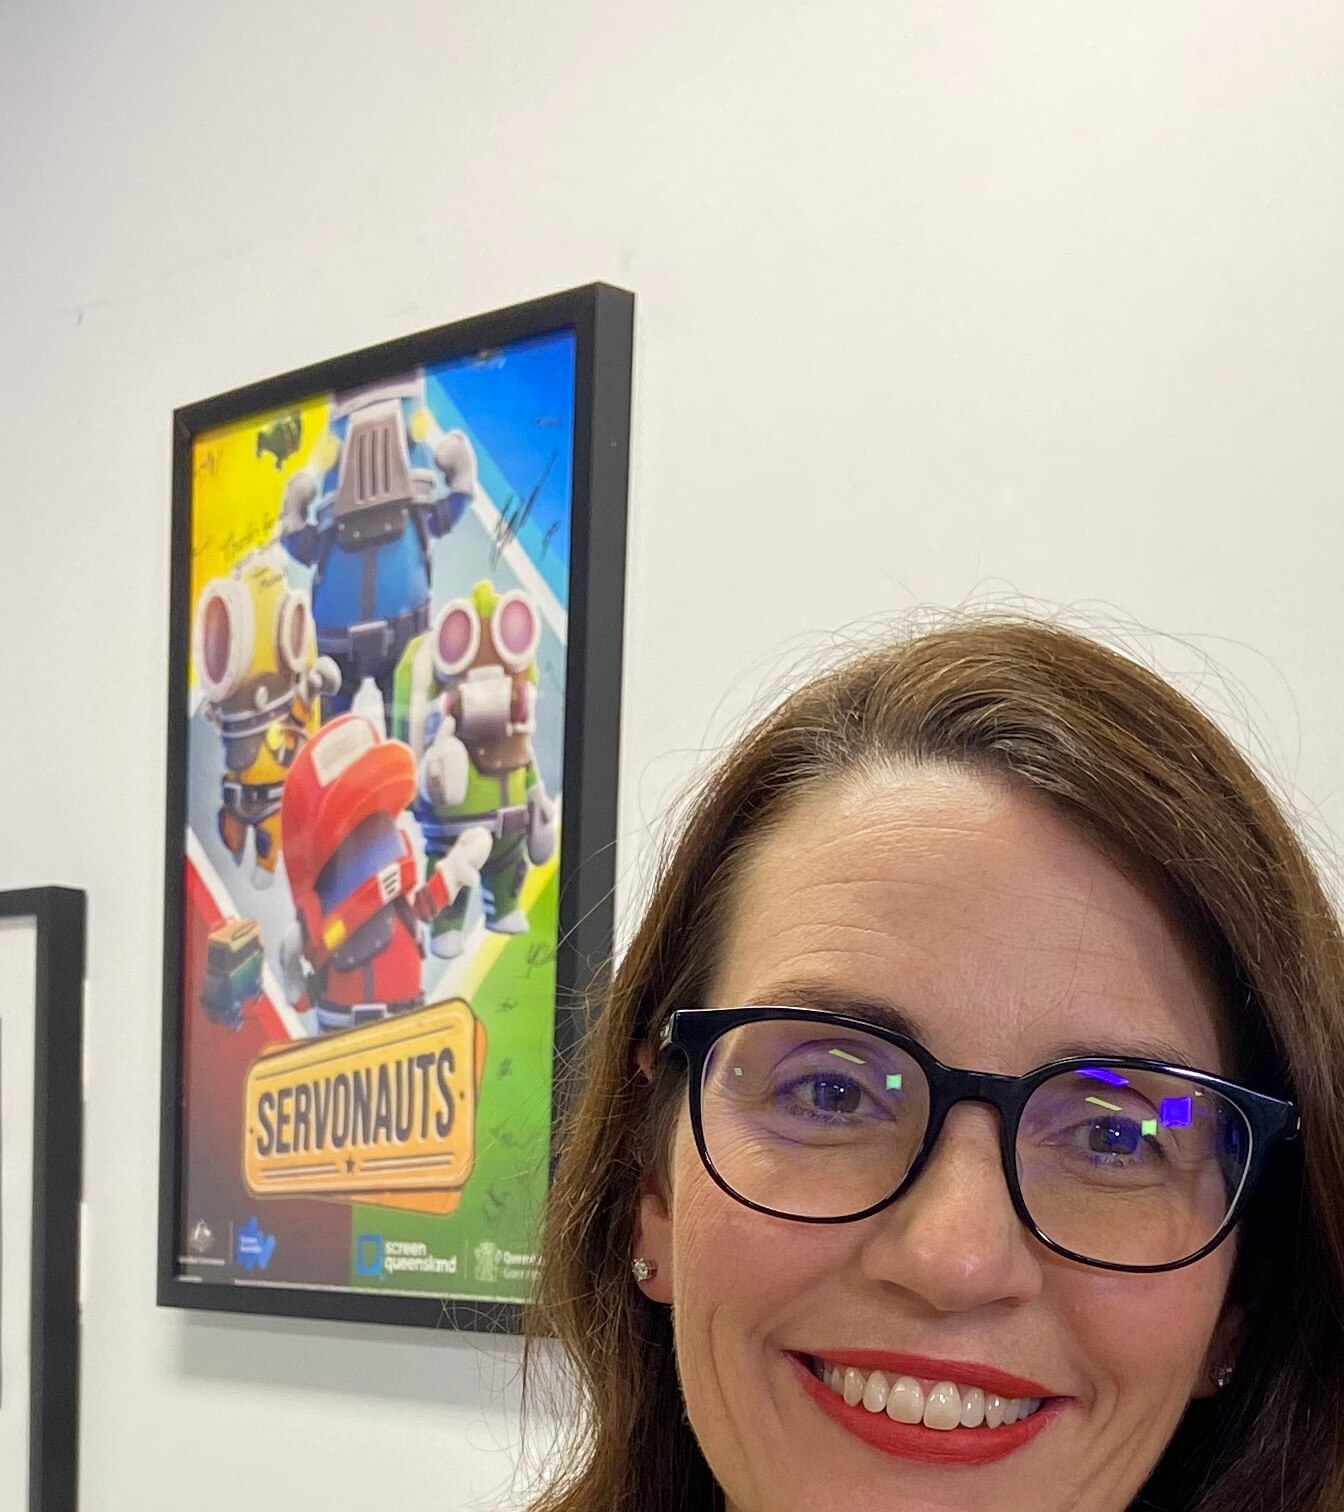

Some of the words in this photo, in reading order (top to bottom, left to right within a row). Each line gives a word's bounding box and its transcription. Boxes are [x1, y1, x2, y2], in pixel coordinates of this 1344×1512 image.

[257, 1047, 455, 1157] SERVONAUTS
[384, 1240, 427, 1256] screen
[384, 1254, 457, 1274] queensland
